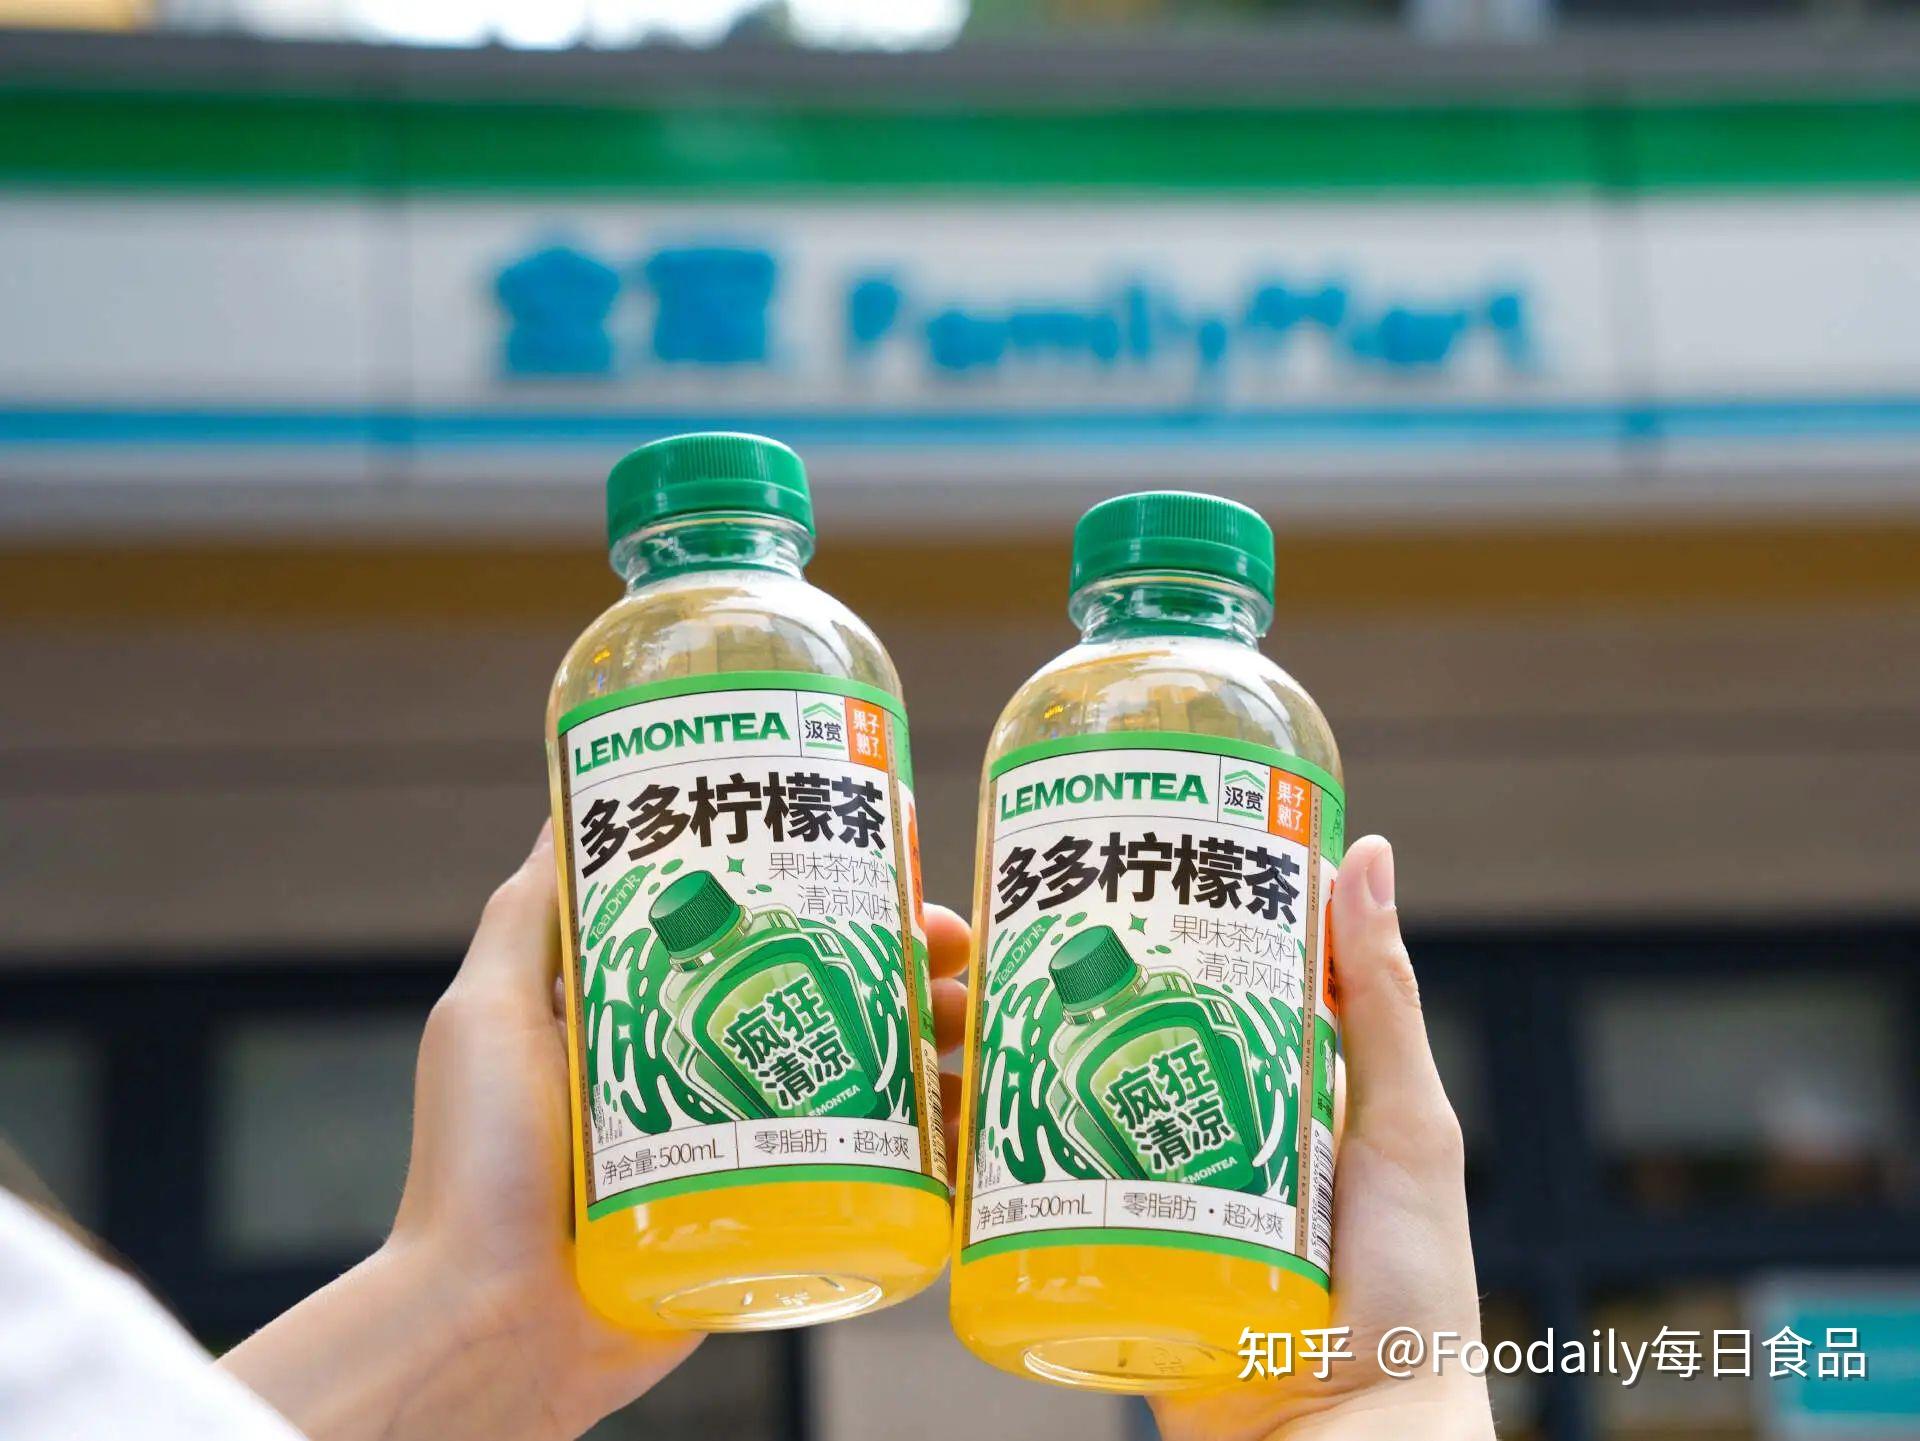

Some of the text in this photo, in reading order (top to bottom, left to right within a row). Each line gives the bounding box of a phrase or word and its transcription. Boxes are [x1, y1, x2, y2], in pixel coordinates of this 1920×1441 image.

[574, 712, 790, 776] LEMONTEA
[804, 720, 843, 743] 汲赏
[580, 772, 886, 878] 多多柠檬茶
[1000, 771, 1209, 822] LEMONTEA
[1224, 786, 1264, 812] 汲赏
[768, 852, 891, 891] 果味茶饮料
[994, 831, 1300, 925] 多多柠檬茶
[592, 874, 641, 940] Tea Drink
[798, 884, 895, 924] 清凉风味
[994, 924, 1046, 985] Tea Drink
[1170, 913, 1298, 964] 果味茶饮料
[1195, 950, 1297, 1000] 清凉风味
[724, 973, 834, 1070] 疯狂
[754, 1029, 855, 1110] 清凉
[1105, 1037, 1221, 1131] 疯狂
[1133, 1099, 1233, 1173] 清凉
